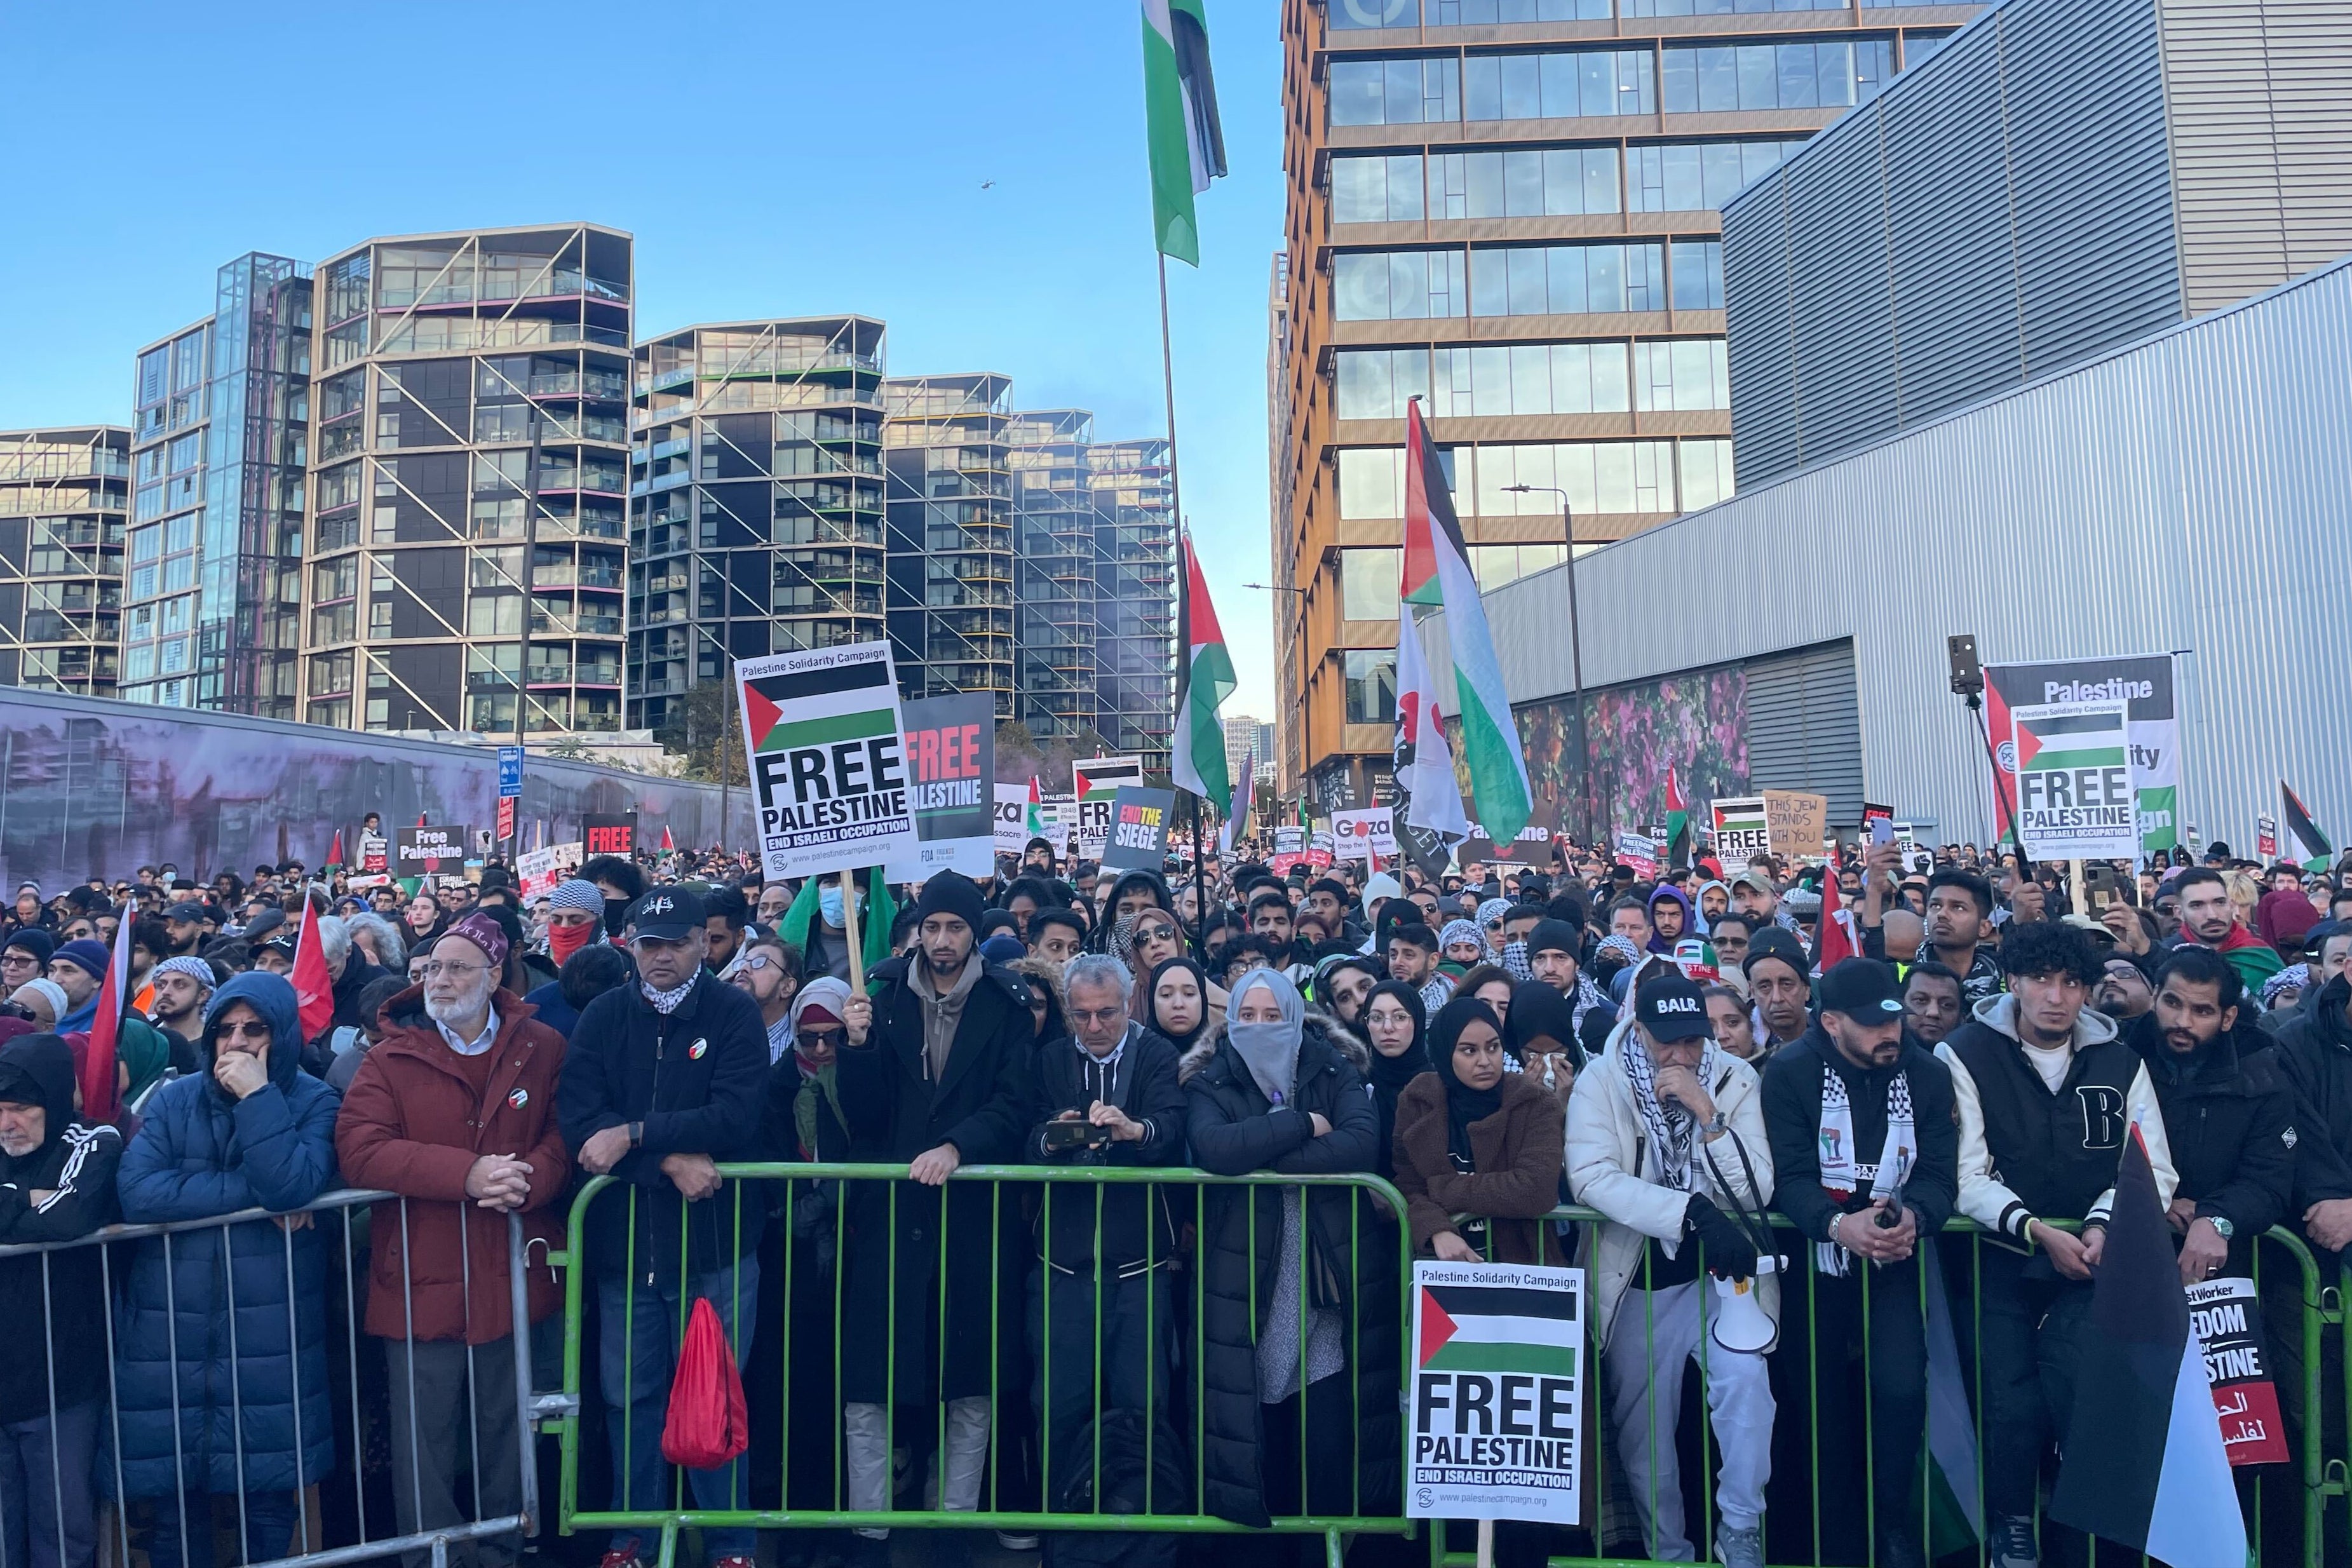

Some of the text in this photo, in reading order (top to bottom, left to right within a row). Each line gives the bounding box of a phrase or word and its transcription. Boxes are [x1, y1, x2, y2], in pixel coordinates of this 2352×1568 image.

[742, 649, 885, 677] Palestine Solidarity Campaign
[2044, 677, 2153, 703] Palestine
[2017, 704, 2122, 718] Palestine Solidarity Campaign
[754, 736, 904, 808] FREE
[911, 779, 982, 810] ALESTINE
[2020, 767, 2128, 810] FREE
[762, 790, 907, 834] PALESTINE
[994, 802, 1022, 823] za
[1119, 804, 1162, 827] END THE
[1767, 799, 1817, 813] THIS JEW
[1769, 813, 1811, 826] STANDS
[2022, 807, 2130, 828] PALESTINE
[416, 829, 447, 844] Free
[768, 819, 909, 851] END ISRAELI OCCUPATION
[1115, 823, 1159, 851] SIEGE
[1335, 820, 1390, 837] Gza
[1651, 827, 1667, 837] Fre
[1791, 829, 1816, 844] YOU
[2025, 827, 2130, 839] END ISRAELI OCCUPATION
[588, 827, 631, 853] FREE
[1623, 839, 1654, 851] FREEDOM
[1717, 829, 1768, 849] FREE
[400, 844, 463, 860] Palestine
[792, 842, 891, 863] www.palestinecampaign.org
[921, 849, 933, 862] FOA
[1621, 847, 1654, 861] PALESTINE
[1719, 847, 1769, 858] PALESTINE
[1687, 964, 1712, 973] STINE
[1657, 997, 1700, 1013] BALR.
[2076, 1086, 2126, 1149] B
[1422, 1270, 1576, 1289] Palestine Solidarity Campaign
[2197, 1285, 2234, 1301] Worker
[2201, 1341, 2212, 1355] or
[2203, 1347, 2263, 1384] STINE
[1417, 1374, 1574, 1440] FREE
[1416, 1436, 1572, 1470] PALESTINE
[1417, 1470, 1571, 1489] END ISRAELI OCCUPATION
[1440, 1493, 1547, 1507] www.palestinecampaign.org
